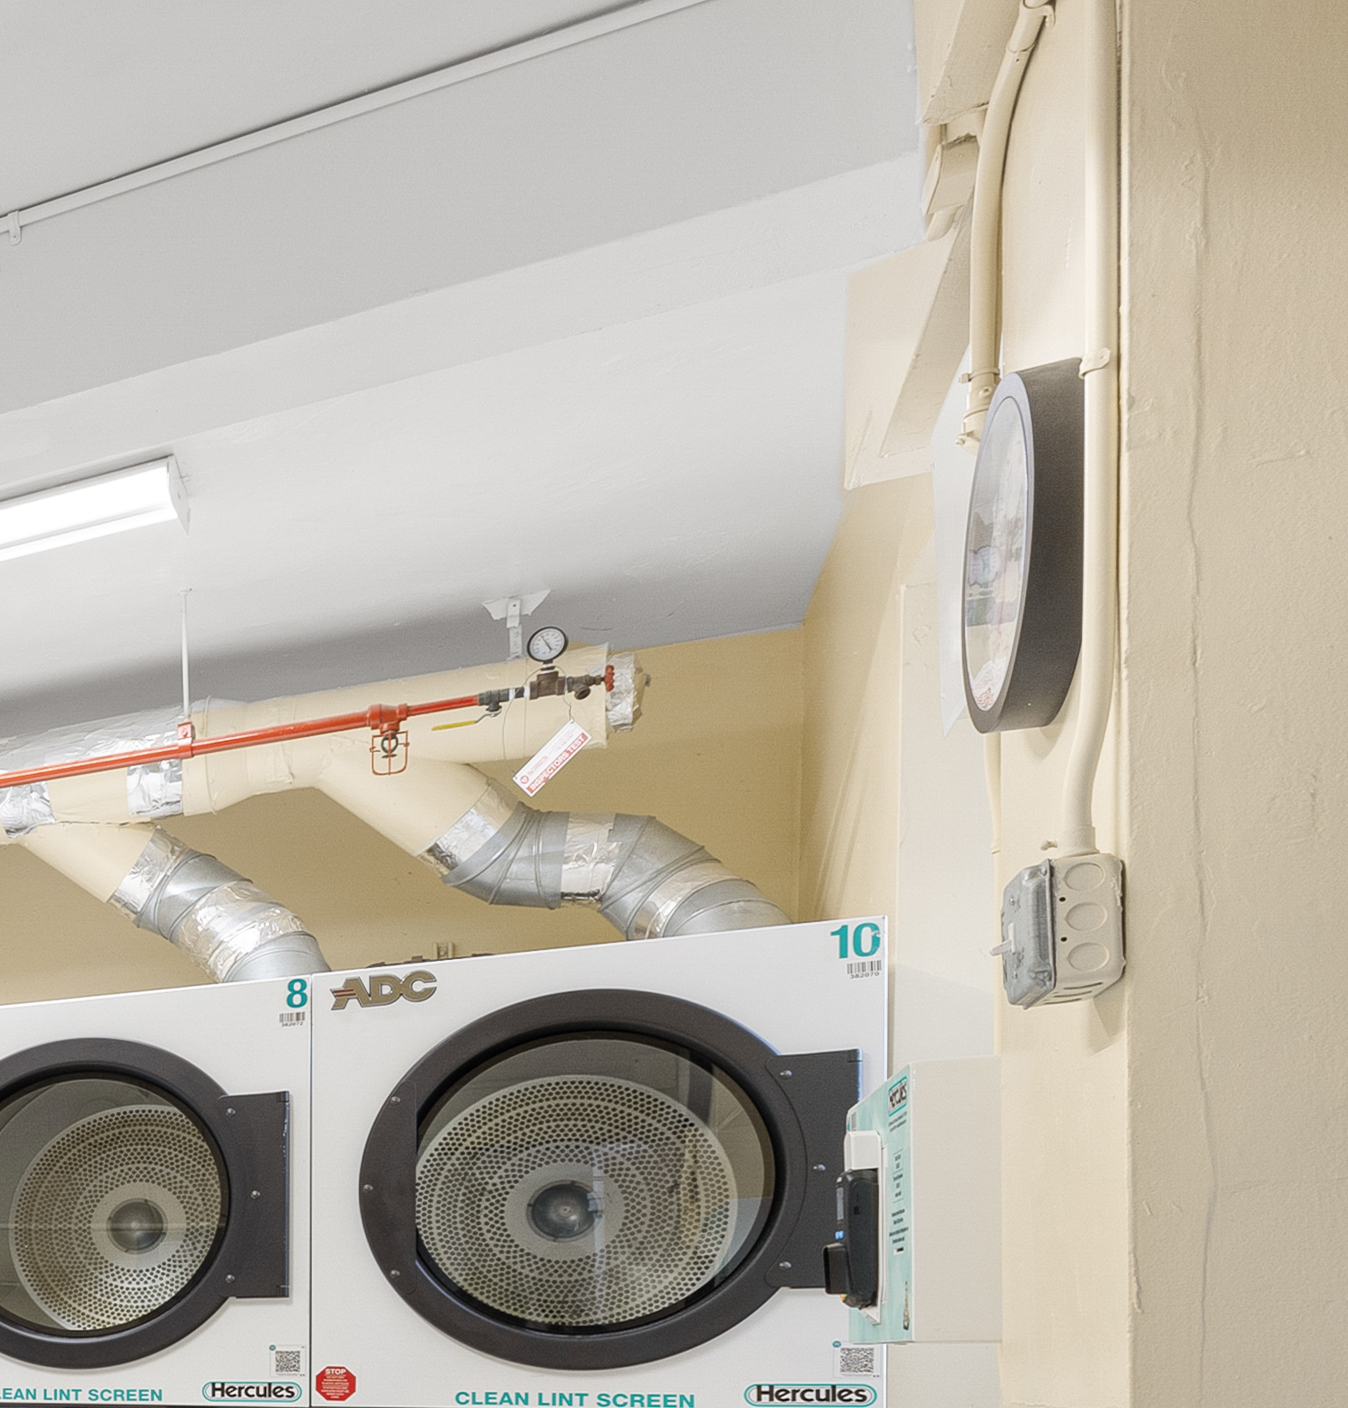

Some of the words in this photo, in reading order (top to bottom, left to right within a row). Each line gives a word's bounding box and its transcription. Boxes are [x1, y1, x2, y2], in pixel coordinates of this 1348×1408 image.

[530, 750, 569, 791] INSPECTORS
[568, 734, 585, 754] TEST
[830, 922, 881, 959] 10
[286, 979, 308, 1009] 8
[330, 969, 438, 1011] ADC
[325, 1368, 347, 1376] STOP
[43, 1388, 82, 1401] LINT
[88, 1389, 163, 1402] SCREEN
[211, 1382, 296, 1399] Hercules
[756, 1385, 868, 1402] Hercules
[455, 1391, 529, 1405] CLEAN
[538, 1392, 589, 1406] LINT
[596, 1393, 695, 1408] SCREEN
